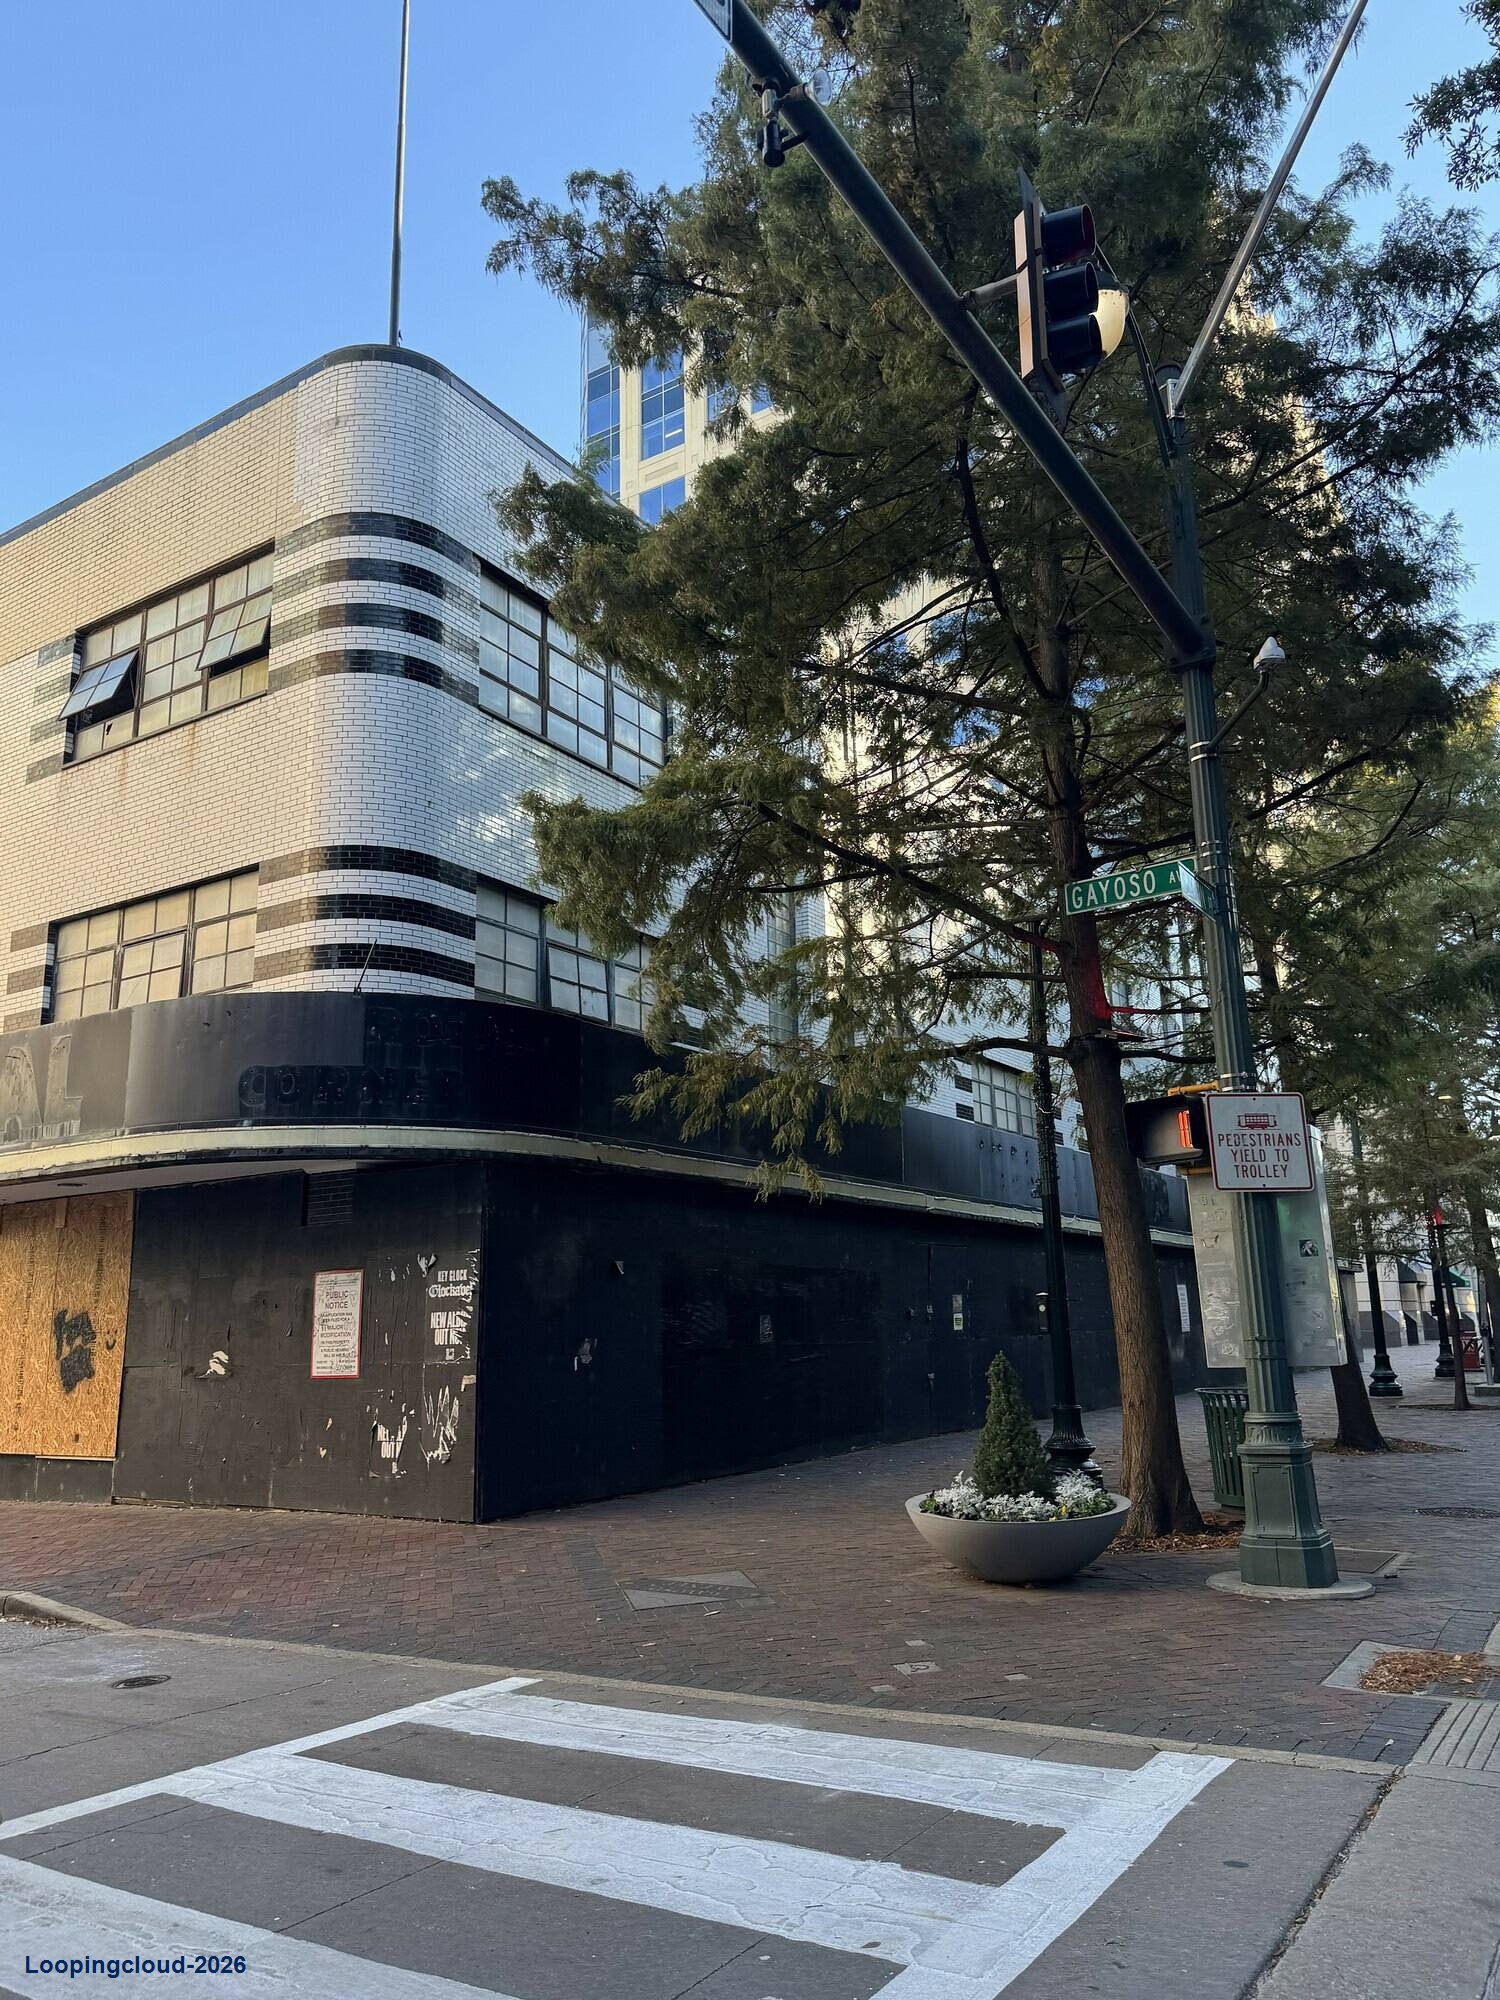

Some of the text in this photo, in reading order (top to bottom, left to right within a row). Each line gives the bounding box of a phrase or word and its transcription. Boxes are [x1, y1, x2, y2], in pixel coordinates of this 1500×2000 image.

[1072, 870, 1156, 909] GAYOSO
[1217, 1133, 1302, 1147] PEDESTRIANS
[1230, 1149, 1289, 1163] YIELD TO
[1234, 1164, 1288, 1178] TROLLEY
[437, 1269, 468, 1282] KEY GLOCK
[326, 1290, 349, 1299] PUBLIC
[325, 1301, 348, 1310] NOTICE
[430, 1311, 447, 1328] NEW
[434, 1328, 449, 1345] OUT
[381, 1441, 395, 1459] OUT
